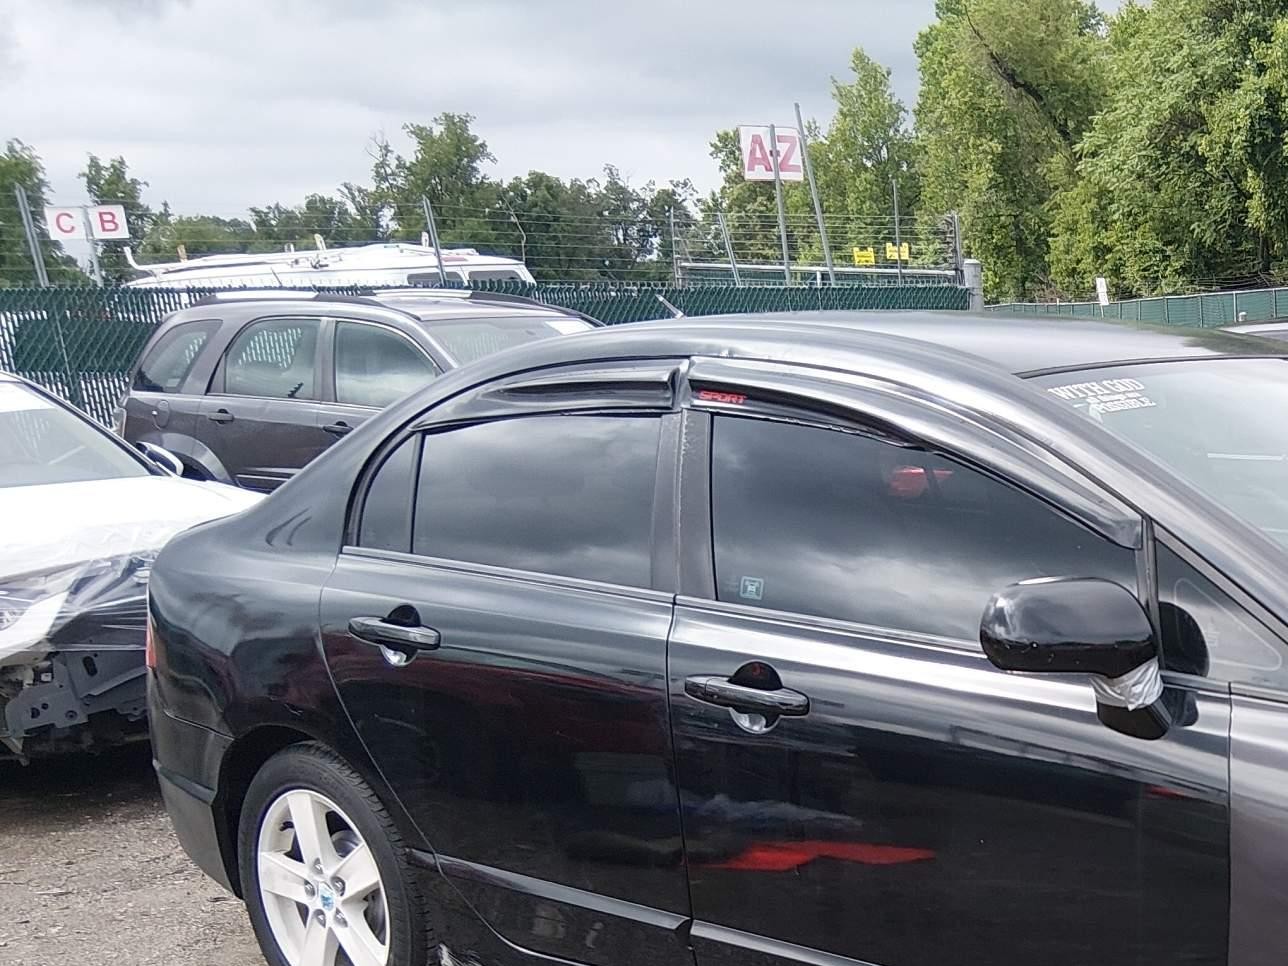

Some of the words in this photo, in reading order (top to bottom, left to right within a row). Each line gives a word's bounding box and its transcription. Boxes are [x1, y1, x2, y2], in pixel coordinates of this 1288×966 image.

[56, 212, 75, 233] C
[99, 211, 119, 232] B
[699, 391, 748, 403] SPORT
[1047, 382, 1112, 400] WITH
[1102, 378, 1145, 393] GOD
